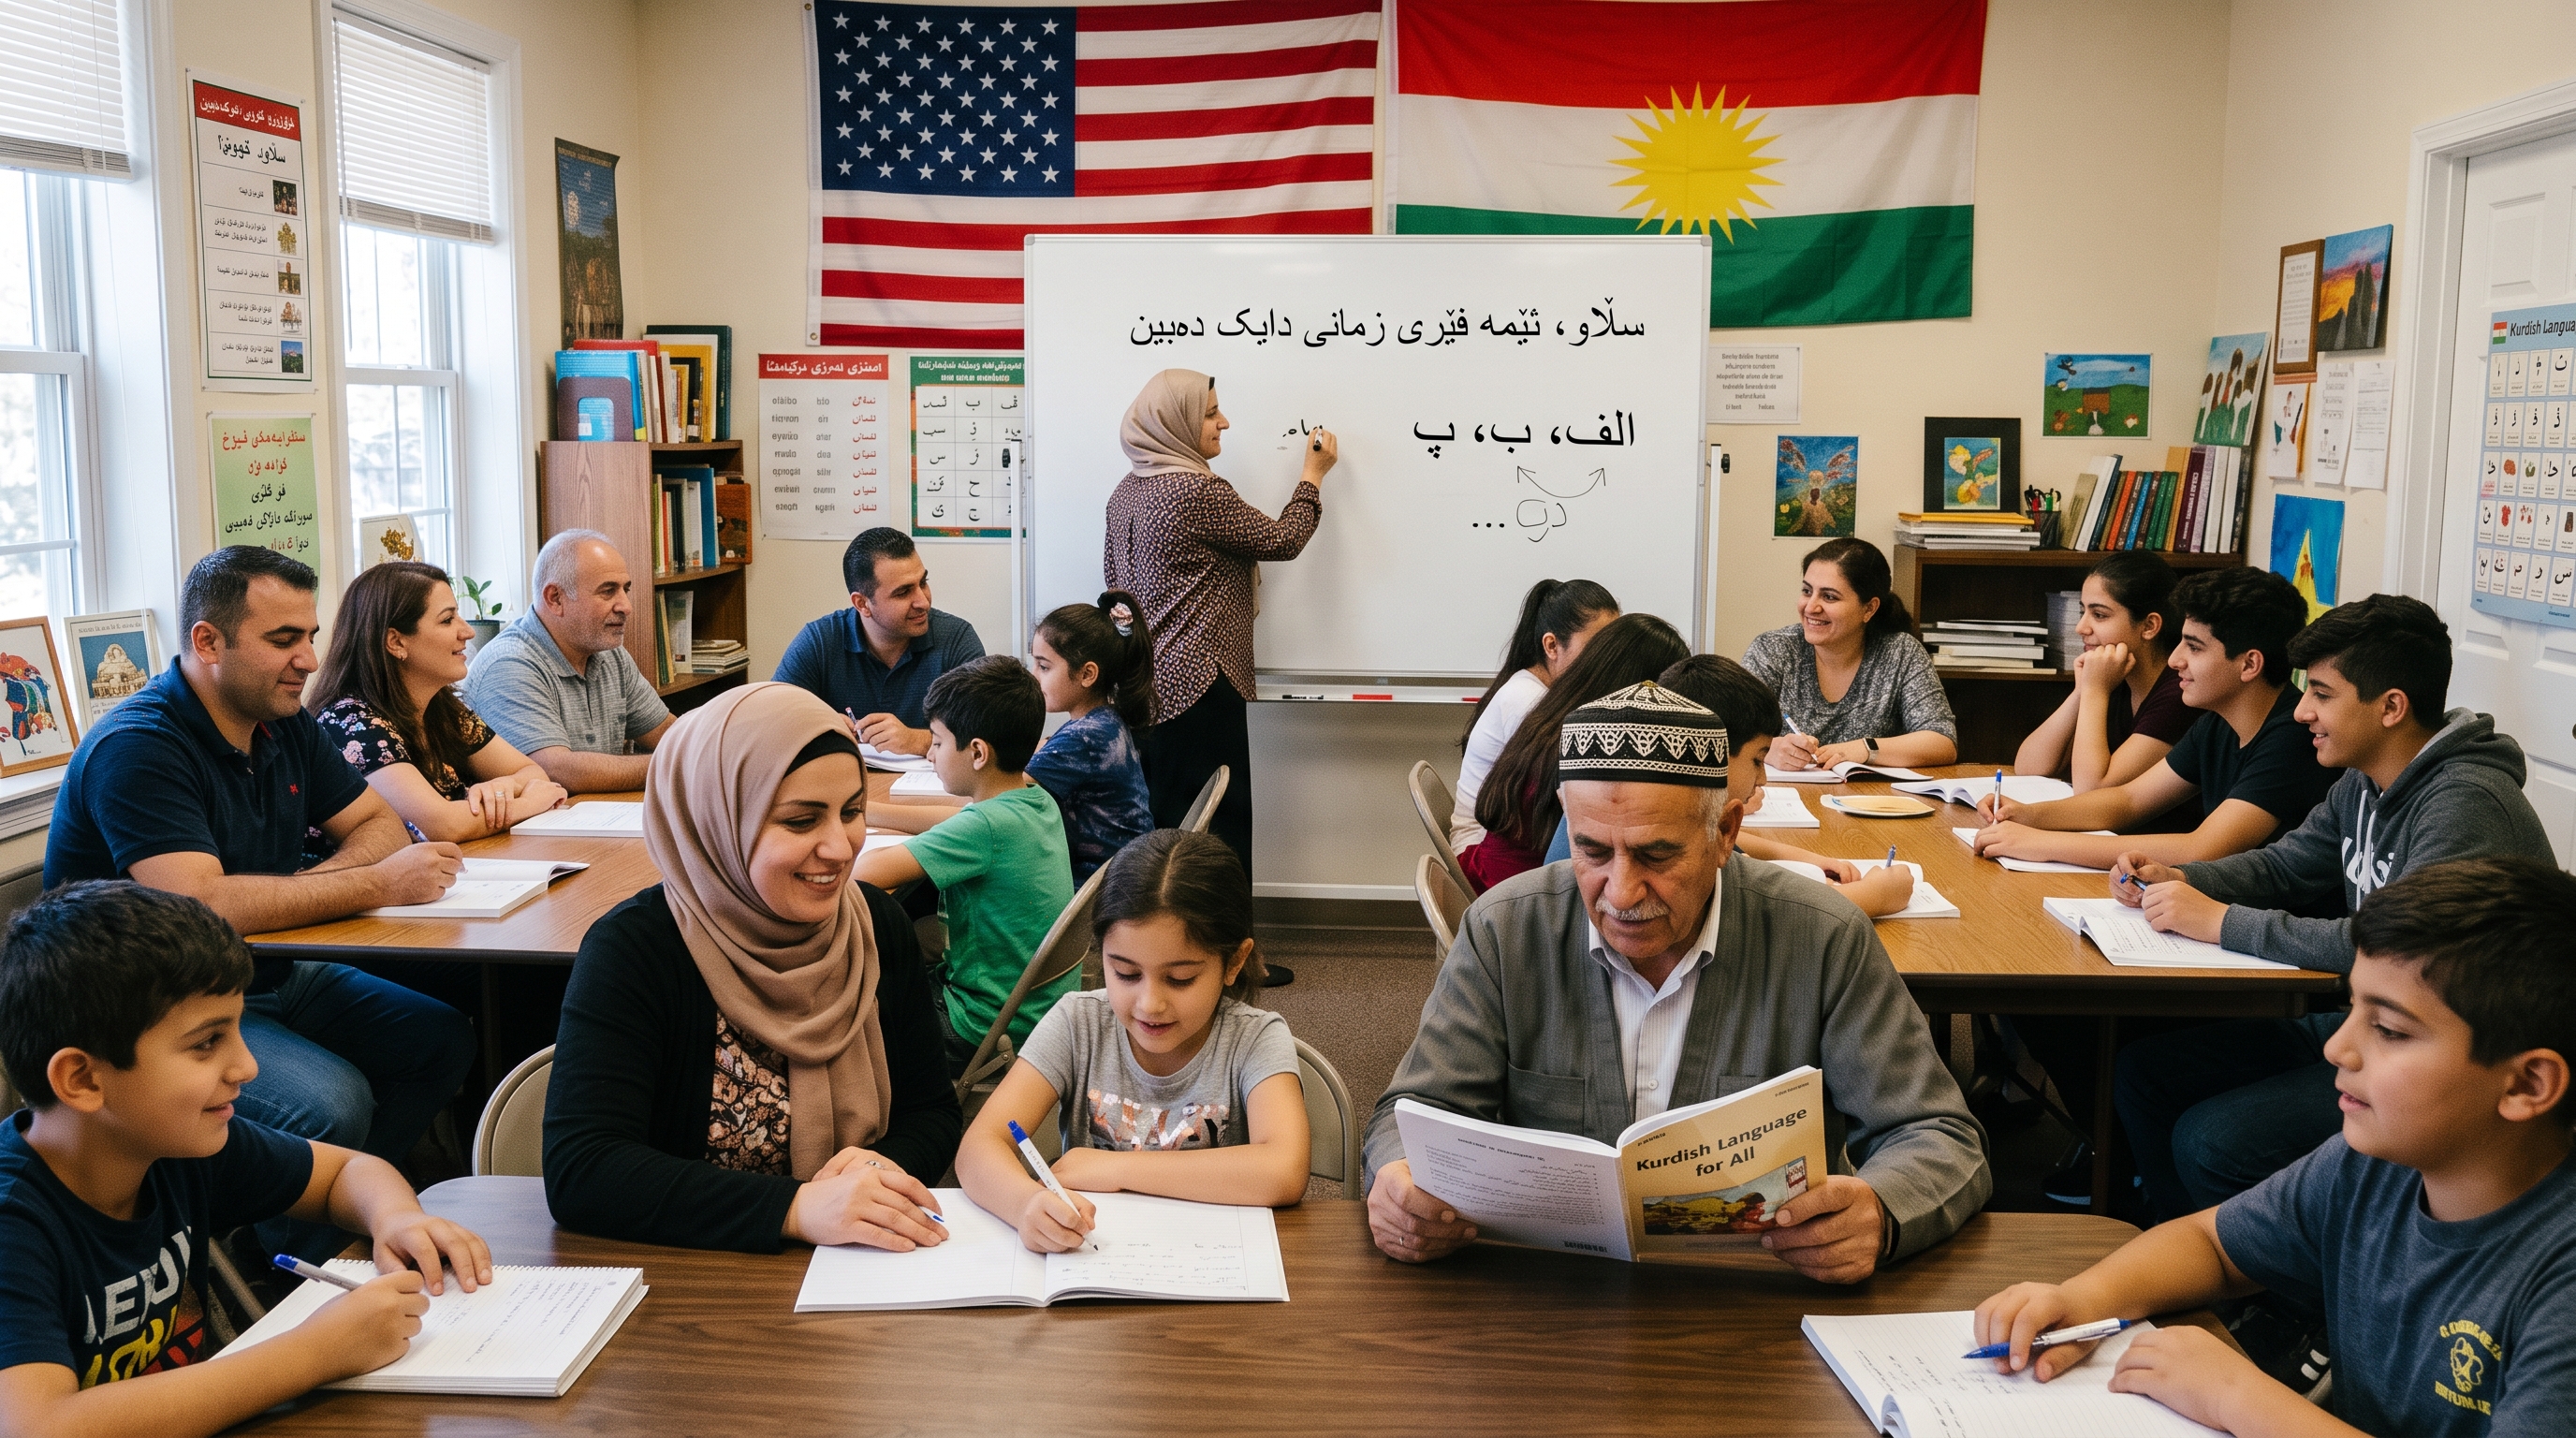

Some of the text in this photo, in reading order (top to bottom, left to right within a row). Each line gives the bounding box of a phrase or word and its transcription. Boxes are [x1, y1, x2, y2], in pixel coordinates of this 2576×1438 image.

[1130, 315, 1205, 345] دەبین
[1217, 307, 1292, 346] دایک
[1303, 307, 1385, 348] زمانی
[1398, 307, 1469, 346] فێری
[2510, 319, 2576, 337] Kurdish Langua
[1413, 421, 1456, 460] پ
[1636, 1108, 1808, 1171] Kurdish Language
[1695, 1145, 1755, 1177] for All
